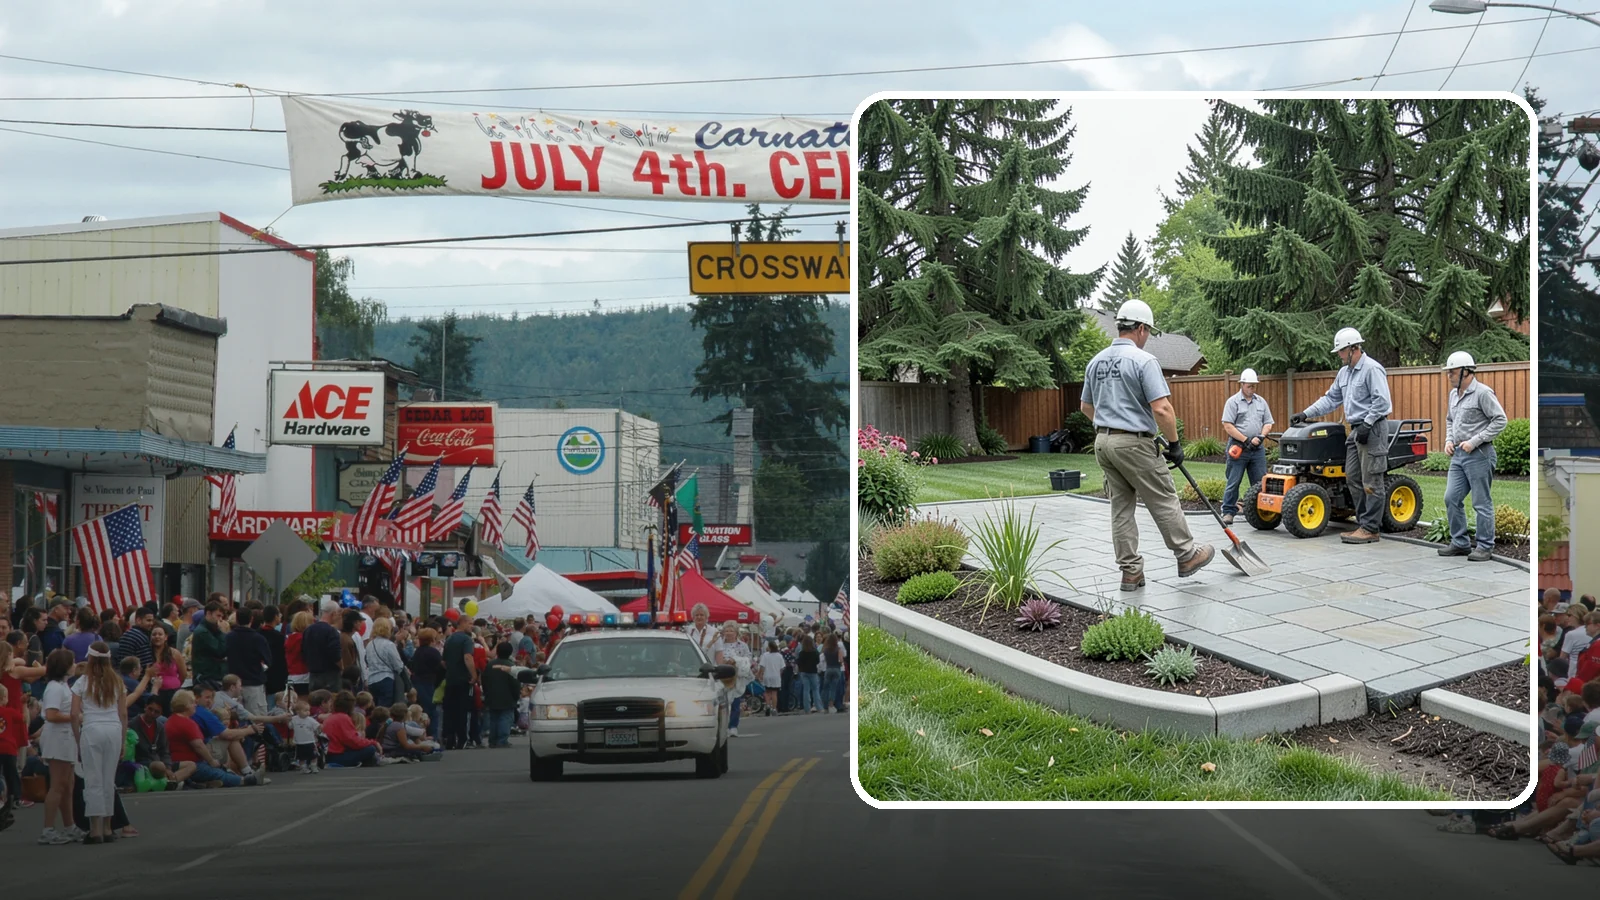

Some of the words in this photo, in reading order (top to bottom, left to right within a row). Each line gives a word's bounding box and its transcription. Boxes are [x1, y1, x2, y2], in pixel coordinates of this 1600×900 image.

[694, 121, 850, 150] Carnat
[481, 141, 605, 192] JULY
[632, 149, 747, 198] 4th.
[696, 254, 850, 280] CROSSWA
[282, 380, 373, 420] ACE
[406, 409, 453, 422] CEDAR
[283, 421, 371, 436] Hardware
[353, 467, 385, 480] Simpl
[96, 485, 124, 495] Vincent
[126, 486, 136, 495] de
[137, 486, 155, 495] Paul
[81, 503, 154, 522] THT
[212, 517, 331, 535] HARDARE
[688, 526, 741, 535] CRNATION
[699, 535, 730, 543] GLASS
